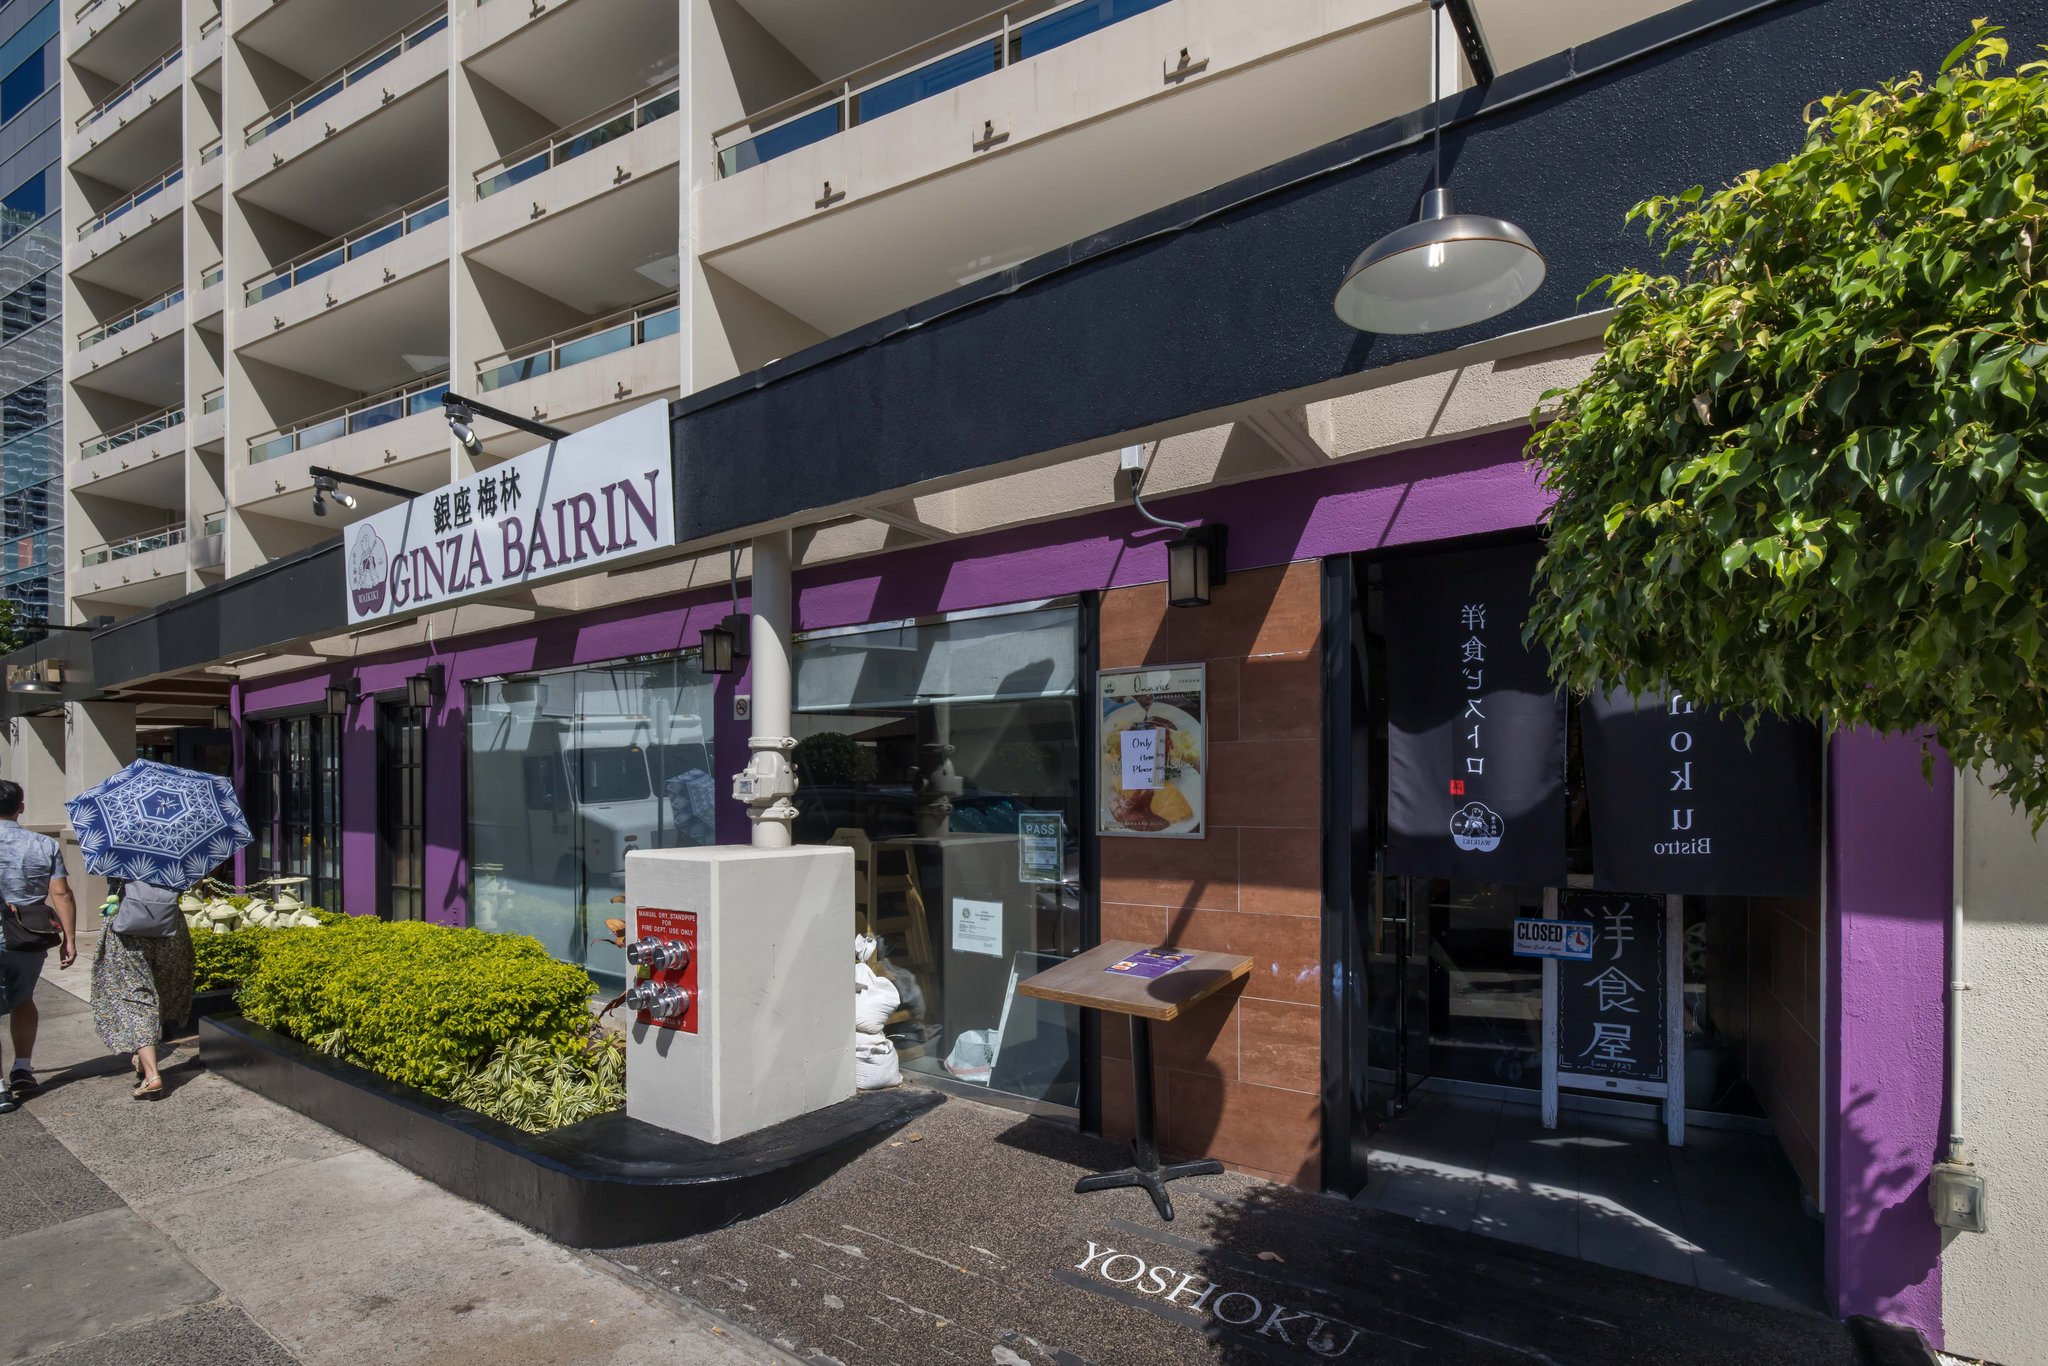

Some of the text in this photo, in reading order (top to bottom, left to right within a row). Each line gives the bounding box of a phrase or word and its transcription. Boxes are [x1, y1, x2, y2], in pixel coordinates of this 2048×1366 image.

[433, 466, 522, 535] 銀座梅林
[389, 468, 660, 608] GINZA BAIRIN
[357, 589, 379, 603] WAIKIKI
[1132, 737, 1153, 751] Only
[1026, 823, 1055, 835] PASS
[638, 910, 658, 918] MANUAL
[669, 913, 696, 922] STANDPIPE
[1517, 921, 1563, 943] CLOSED
[1579, 902, 1646, 1063] 洋食屋
[1074, 1239, 1362, 1358] YOSHOKU
